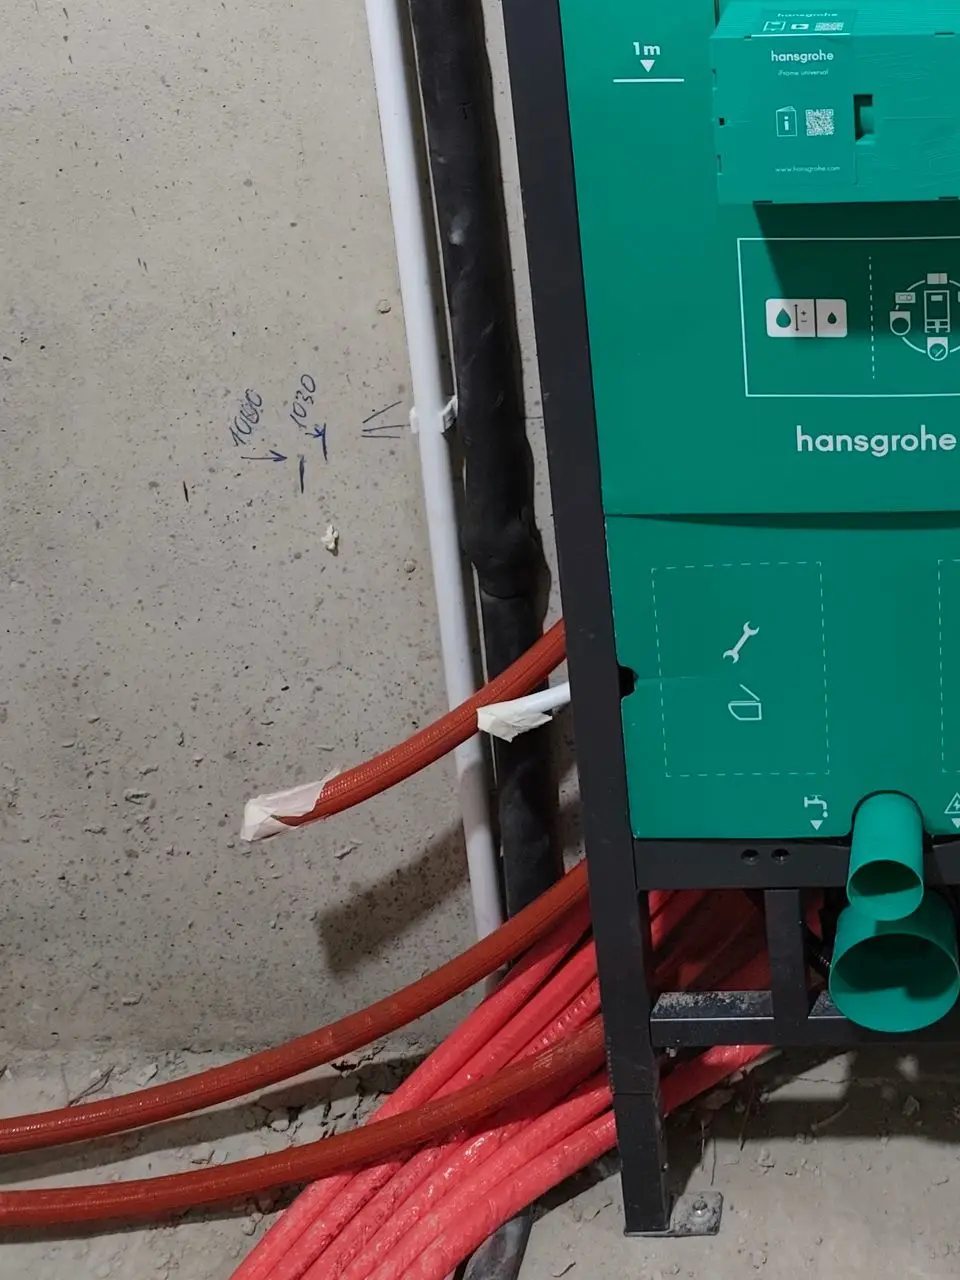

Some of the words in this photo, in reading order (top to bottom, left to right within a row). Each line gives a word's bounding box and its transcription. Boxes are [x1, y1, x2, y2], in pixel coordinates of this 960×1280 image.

[632, 41, 661, 56] 1m
[771, 48, 834, 64] hansgrohe
[289, 373, 316, 429] 1030
[796, 424, 957, 457] hansgrohe
